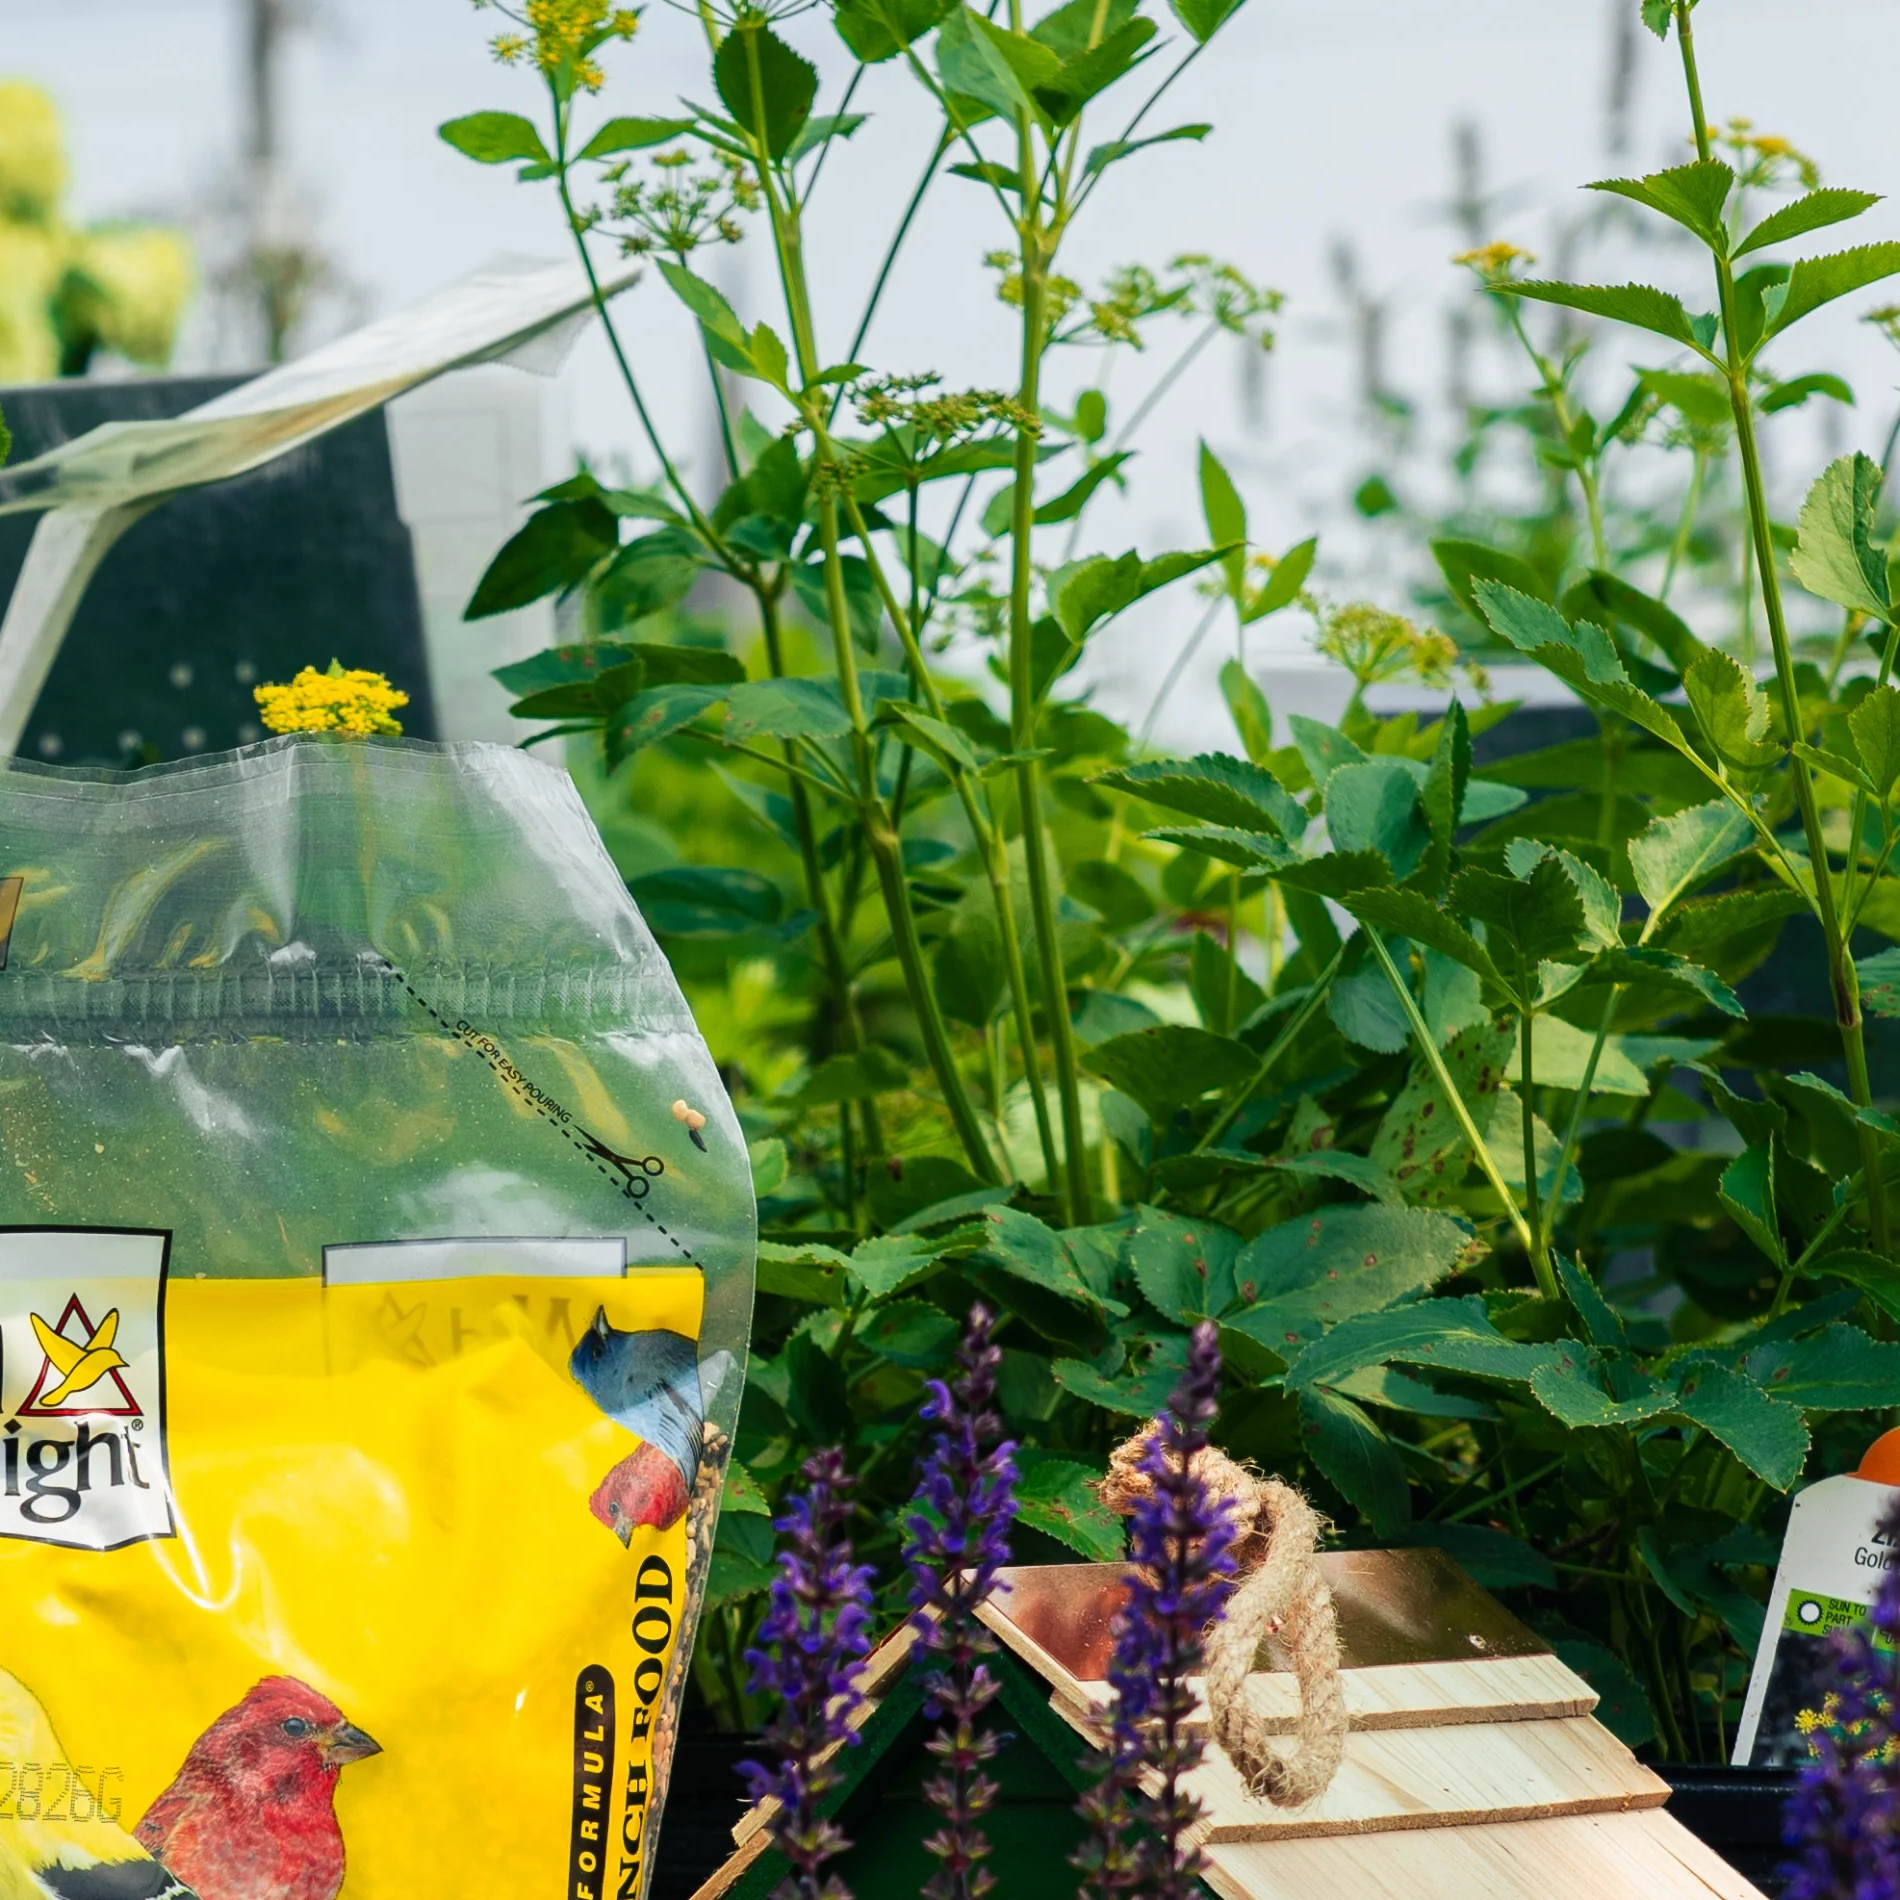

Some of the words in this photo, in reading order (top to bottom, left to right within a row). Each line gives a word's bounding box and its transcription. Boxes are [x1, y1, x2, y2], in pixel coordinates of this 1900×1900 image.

[456, 1020, 480, 1040] CUT
[477, 1037, 500, 1060] FOR
[498, 1058, 527, 1084] EASY
[522, 1082, 573, 1123] POURING
[1825, 1611, 1853, 1627] PART
[1827, 1598, 1850, 1613] SUN
[1854, 1604, 1867, 1617] TO
[630, 1553, 674, 1747] FOOD
